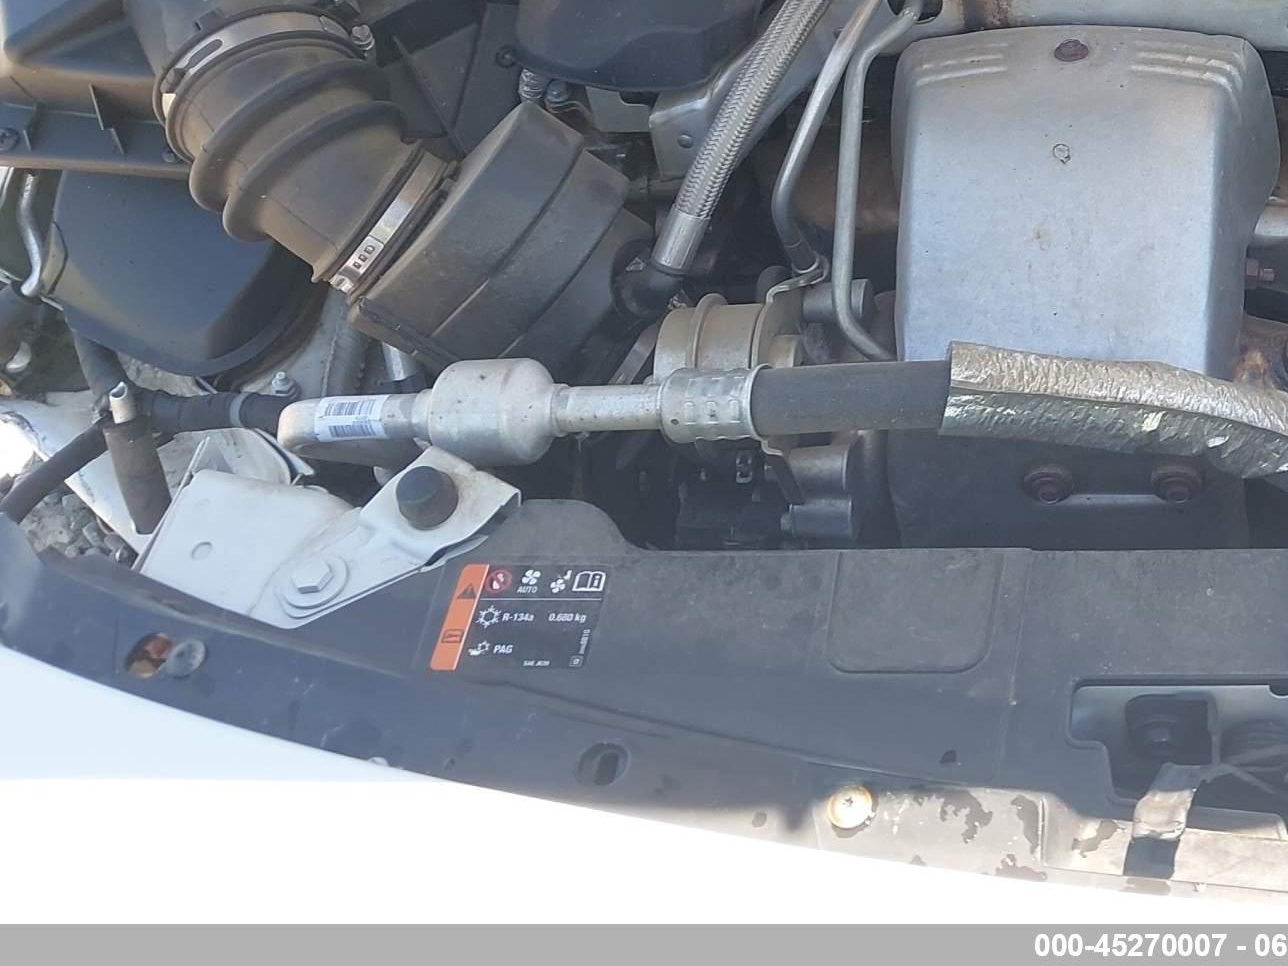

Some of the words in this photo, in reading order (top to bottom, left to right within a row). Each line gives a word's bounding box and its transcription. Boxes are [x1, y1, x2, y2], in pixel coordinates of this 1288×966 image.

[502, 612, 534, 621] R-134a
[574, 612, 587, 623] kg
[493, 645, 513, 653] PAG
